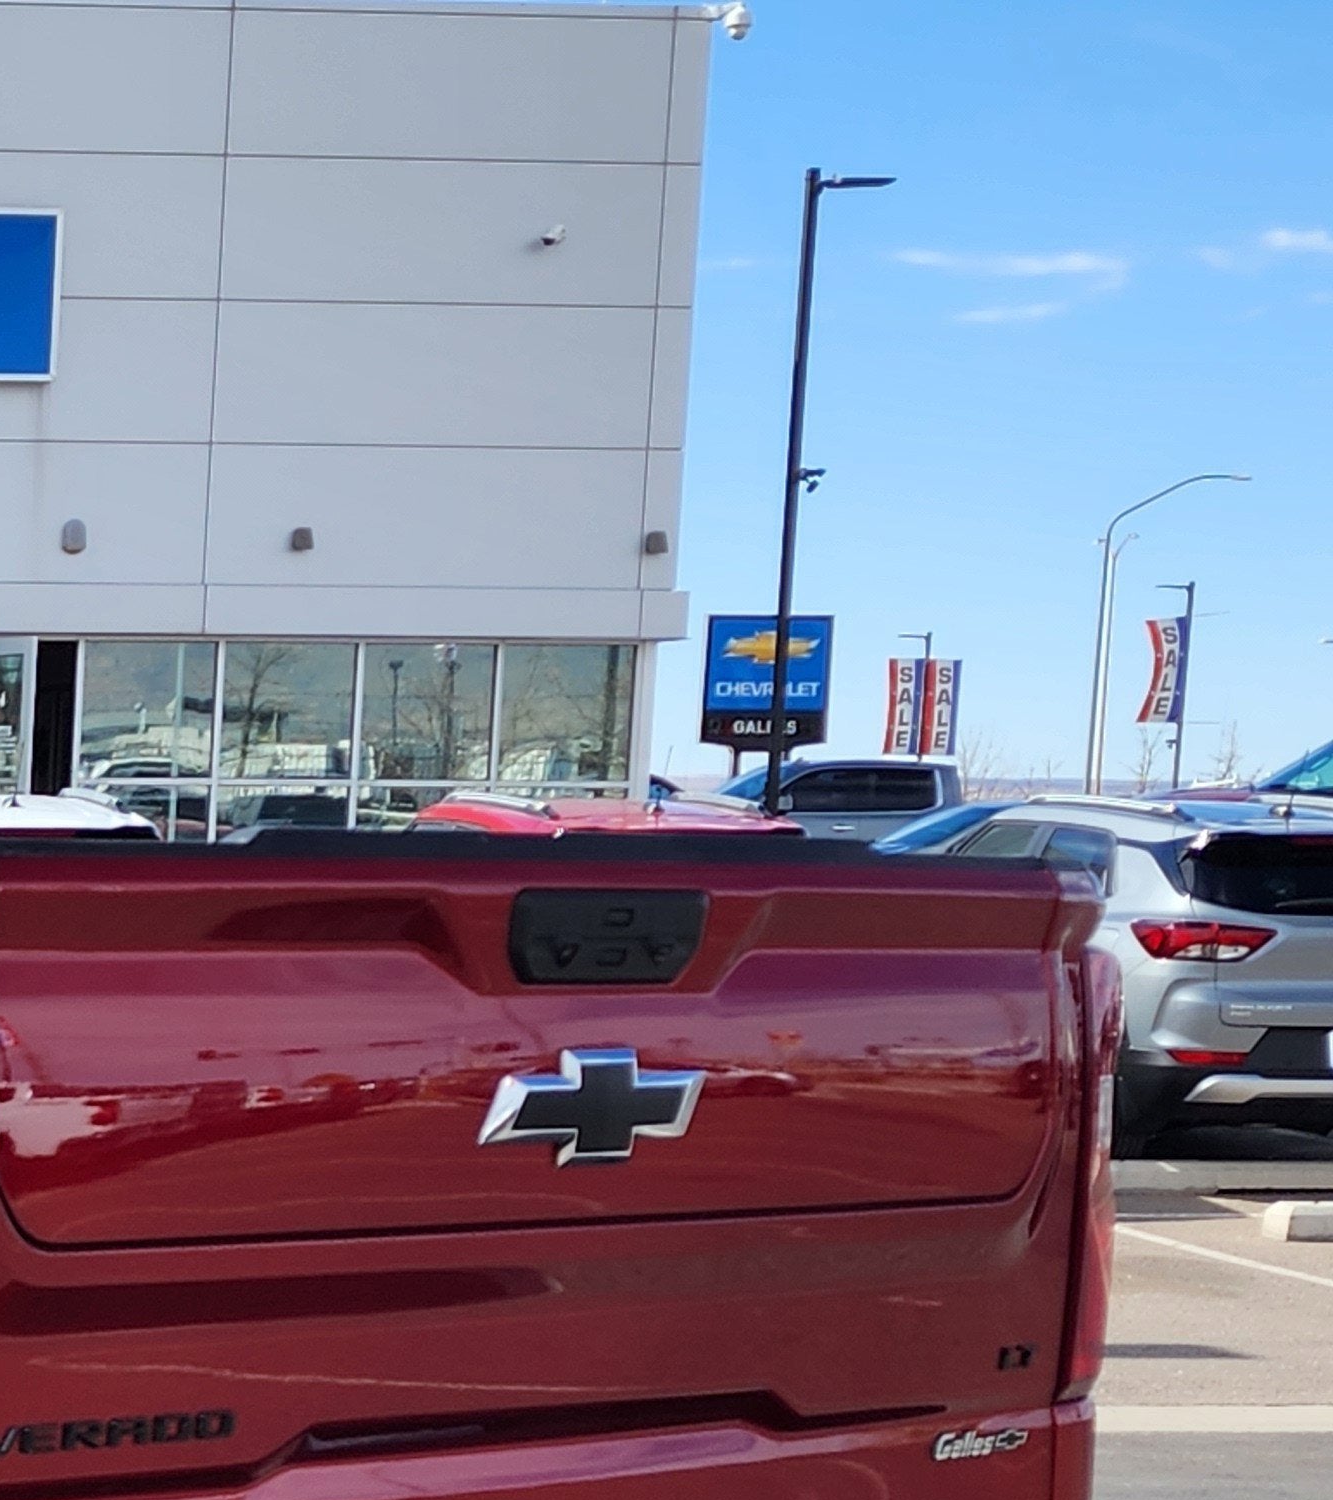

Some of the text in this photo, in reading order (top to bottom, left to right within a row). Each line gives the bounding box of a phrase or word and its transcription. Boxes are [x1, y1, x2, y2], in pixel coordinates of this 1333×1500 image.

[715, 681, 821, 697] CHEVRLET
[895, 666, 913, 748] SALE
[933, 666, 952, 749] SALE
[1152, 626, 1178, 715] SALE
[935, 1430, 996, 1462] Galles
